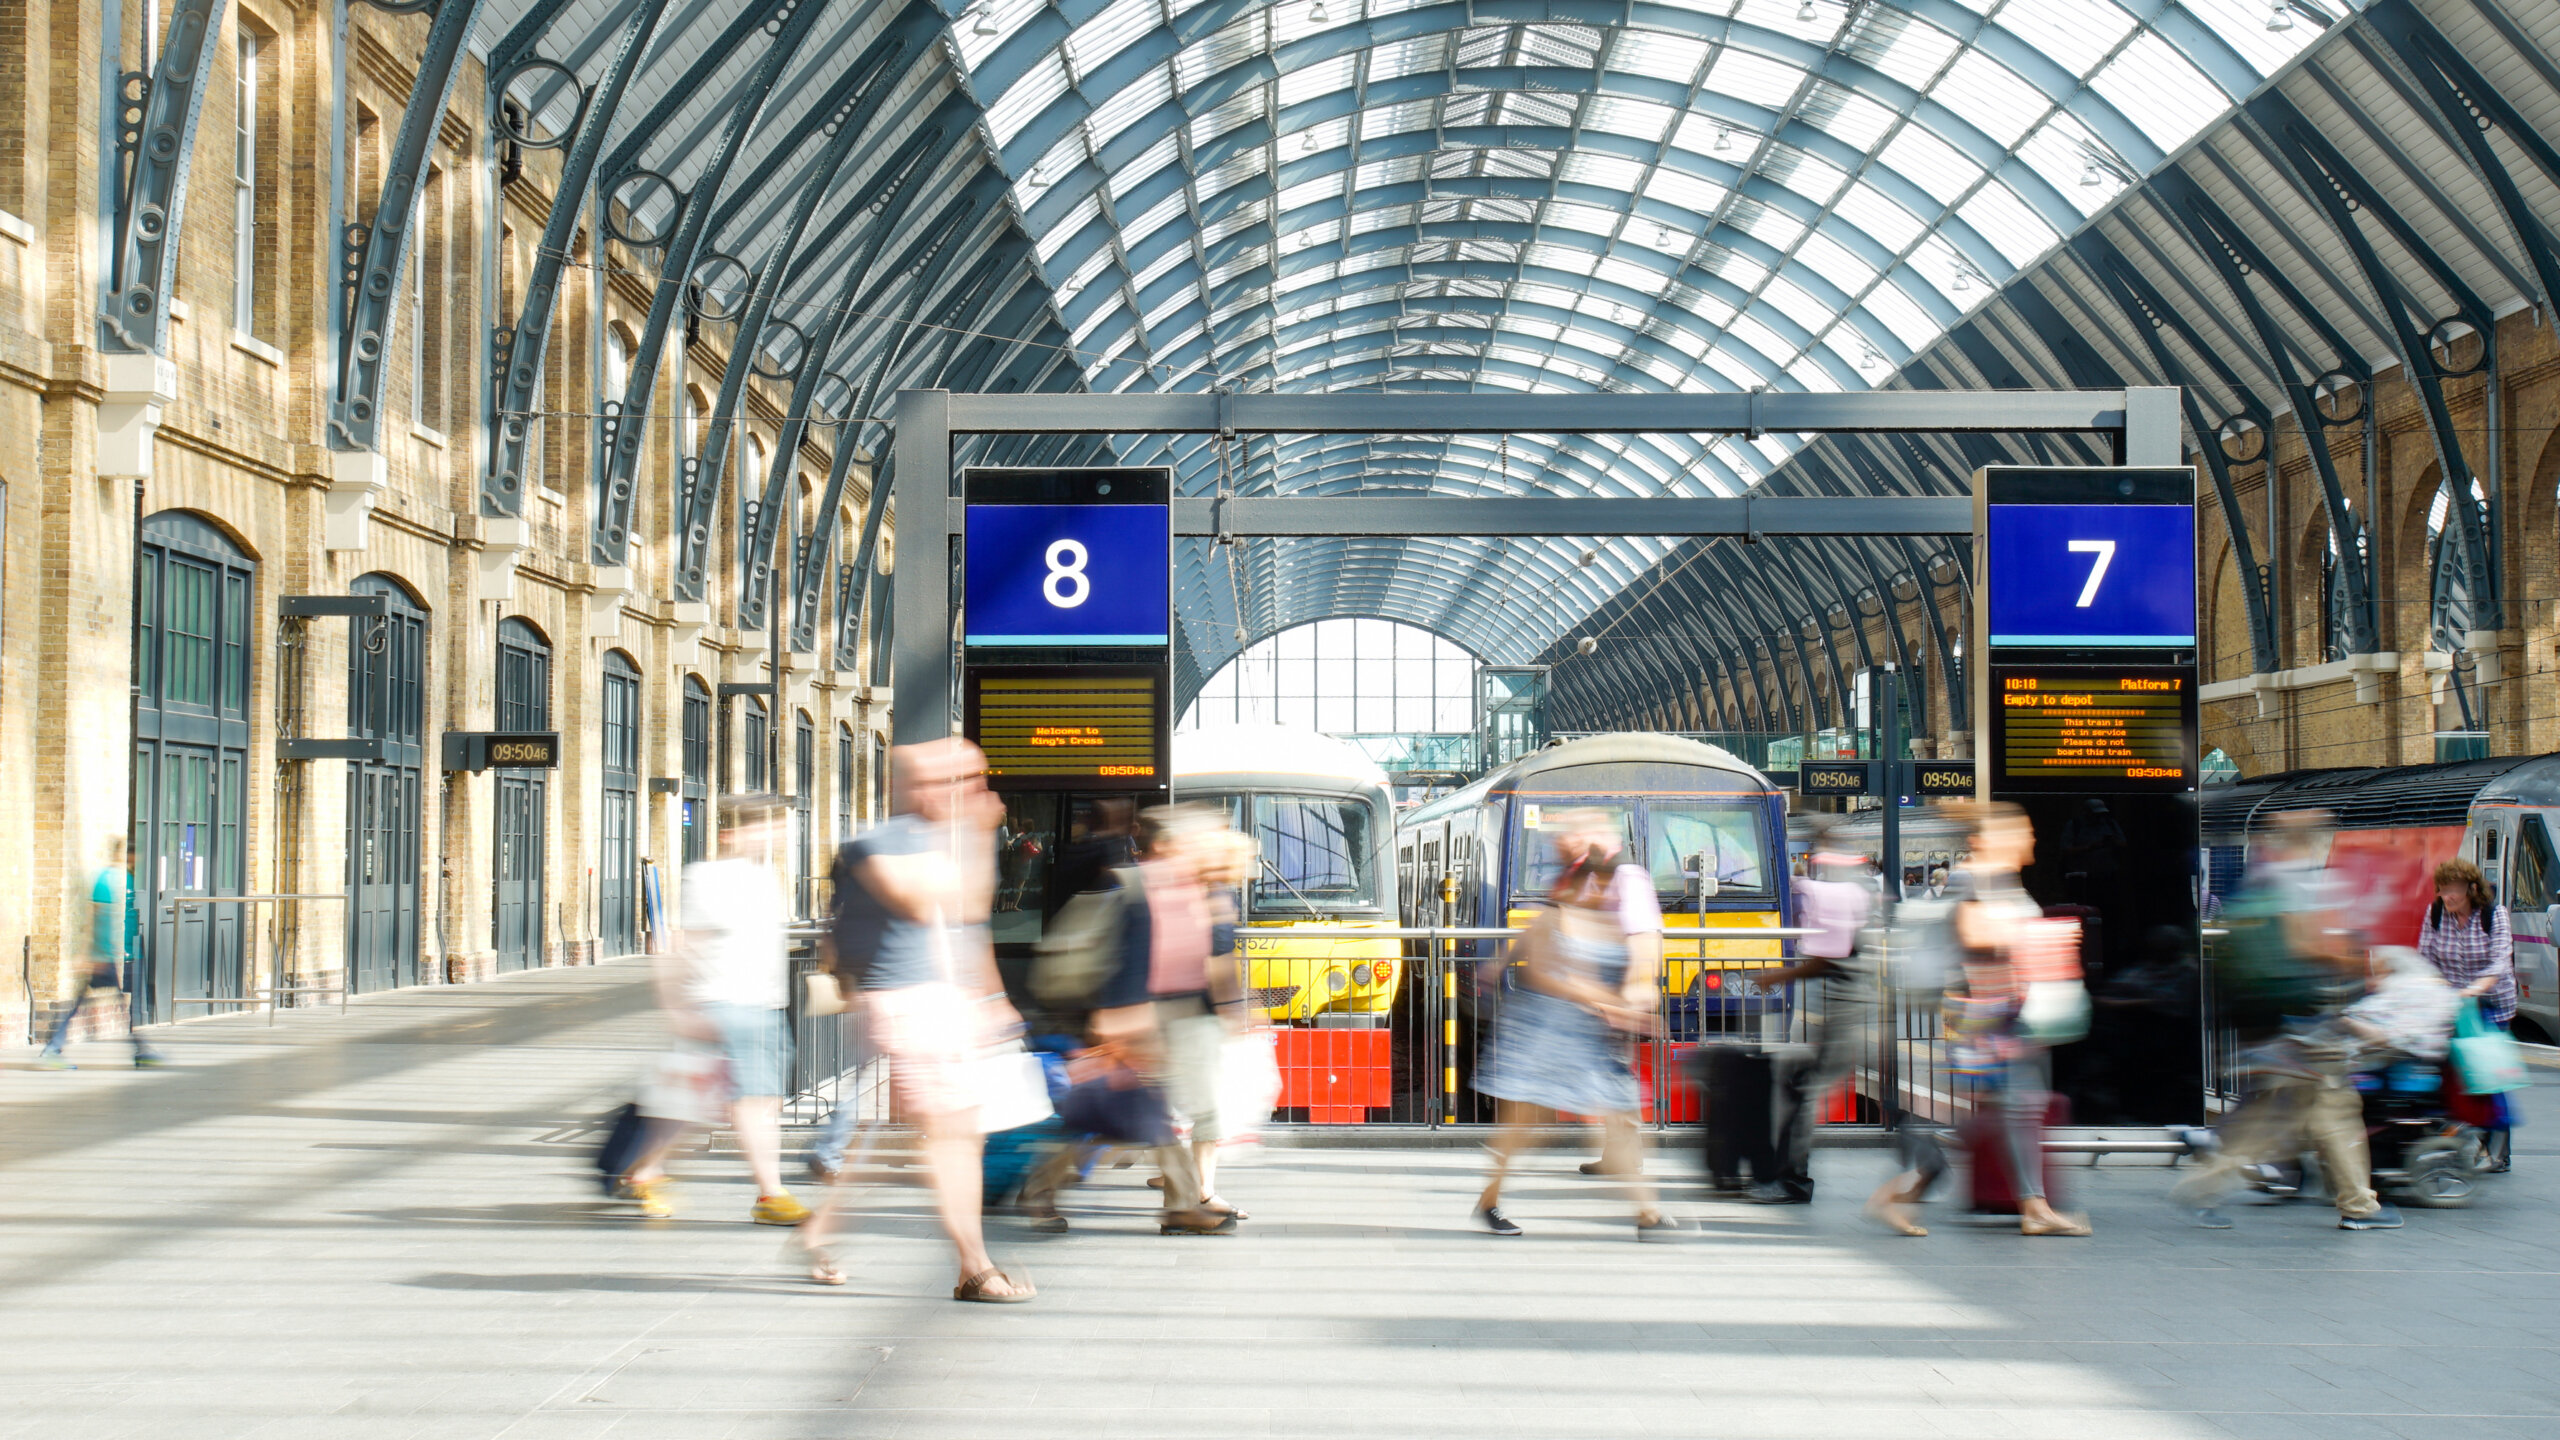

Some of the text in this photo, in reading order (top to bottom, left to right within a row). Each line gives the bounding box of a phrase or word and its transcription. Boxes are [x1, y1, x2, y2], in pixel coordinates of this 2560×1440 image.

[1043, 538, 1090, 608] 8
[2068, 540, 2116, 607] 7
[2005, 678, 2037, 690] 10:18
[2121, 679, 2182, 690] Platform 7
[2004, 694, 2094, 707] Empty to depot
[2064, 718, 2124, 727] This train is
[1035, 727, 1099, 735] Welcome to
[2060, 728, 2127, 736] not in service
[1031, 737, 1104, 747] King's Cross
[2063, 738, 2125, 746] Please do not
[2057, 748, 2132, 757] board this train
[1099, 766, 1155, 776] 09:50:46
[2127, 768, 2182, 778] 09:50:46
